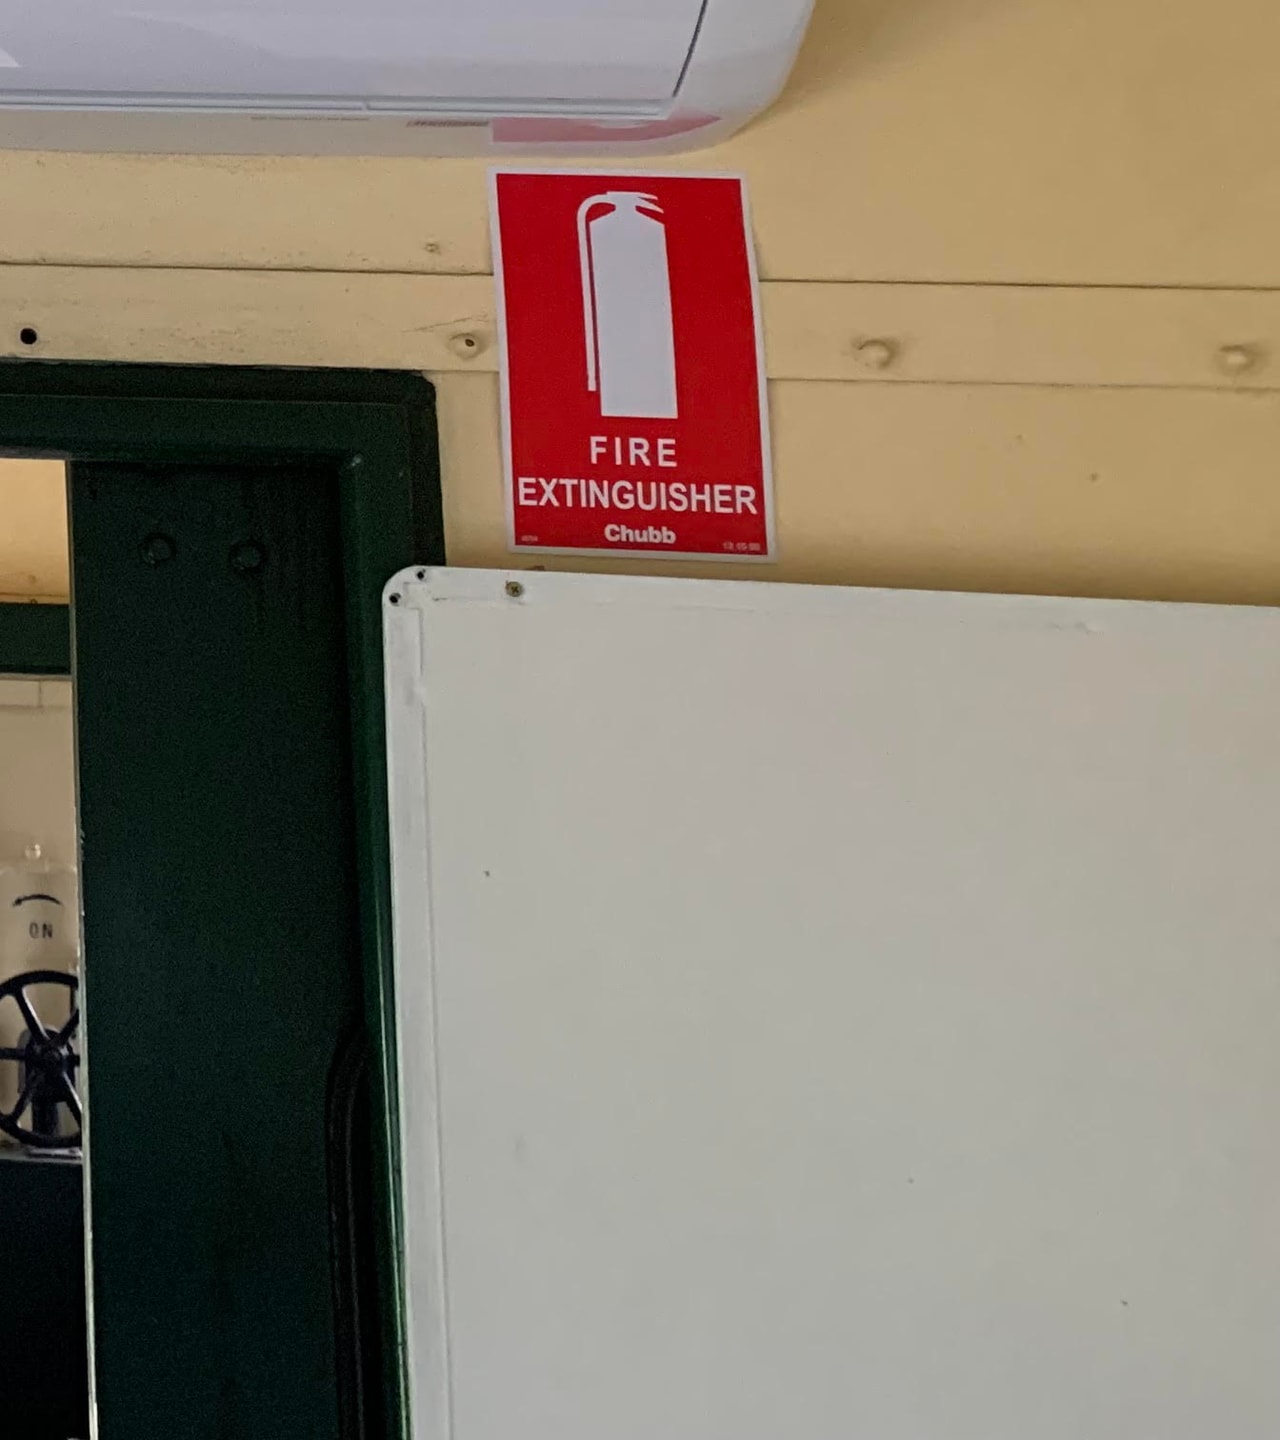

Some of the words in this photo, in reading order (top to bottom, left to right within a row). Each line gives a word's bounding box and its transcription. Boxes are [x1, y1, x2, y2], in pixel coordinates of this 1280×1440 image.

[590, 436, 677, 467] FIRE
[517, 476, 758, 515] EXTINGUISHER
[604, 523, 676, 545] Chubb
[29, 922, 53, 939] ON
